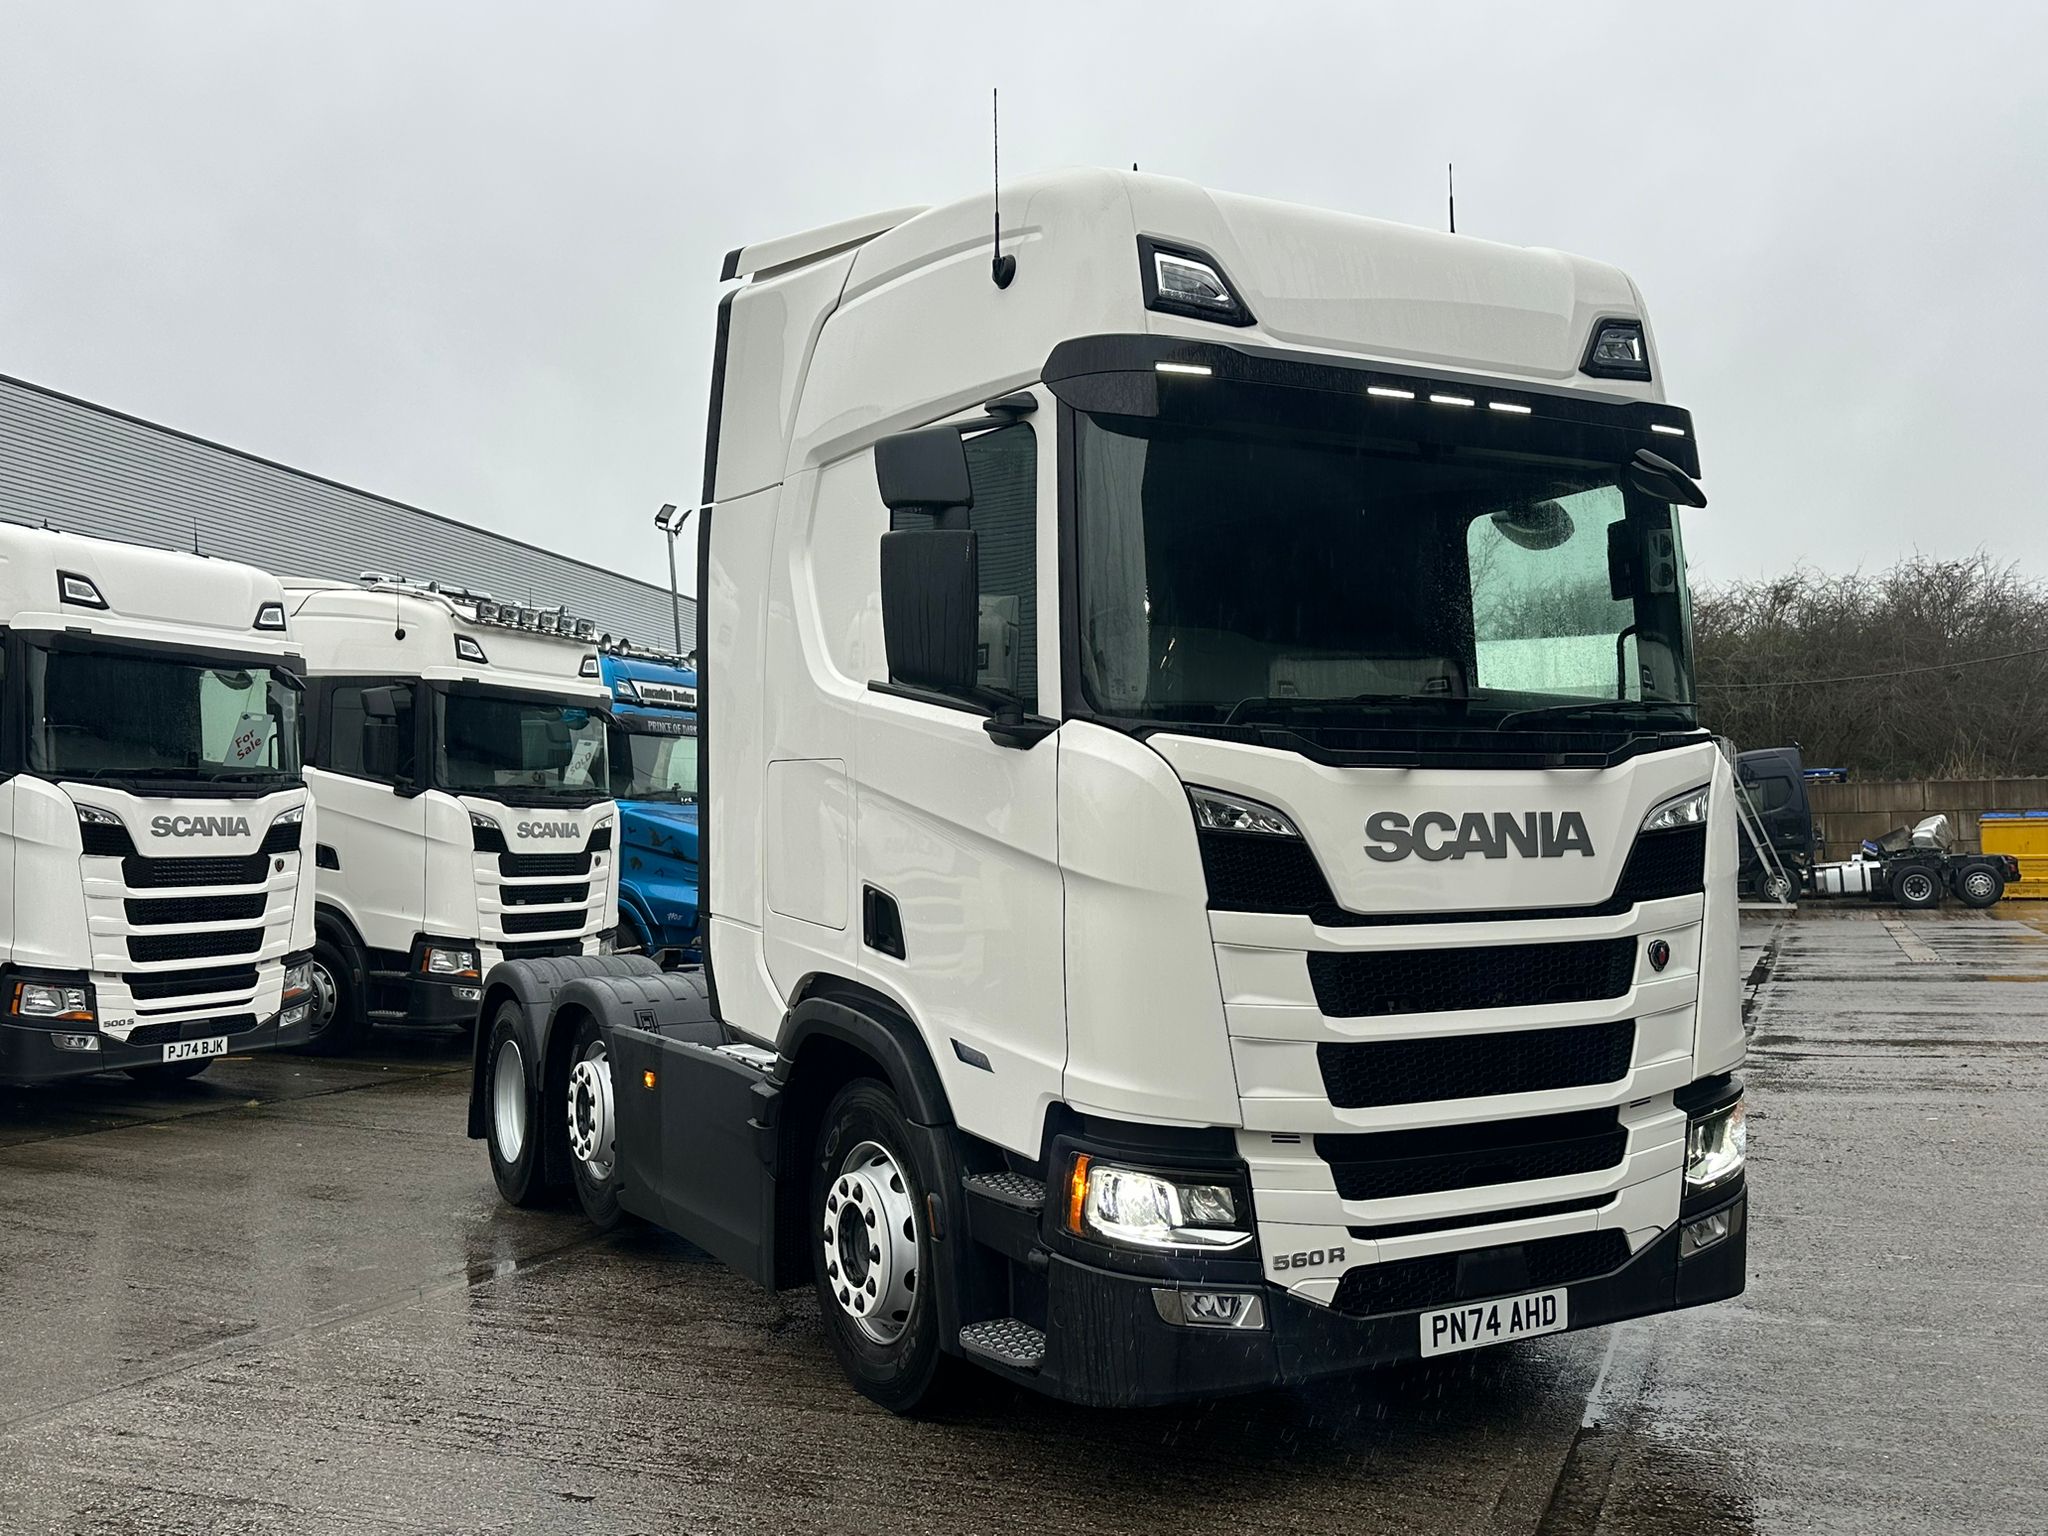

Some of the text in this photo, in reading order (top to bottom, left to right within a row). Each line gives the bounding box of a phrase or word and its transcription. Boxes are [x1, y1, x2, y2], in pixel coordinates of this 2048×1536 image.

[235, 729, 254, 748] For
[237, 737, 262, 760] Sale
[150, 816, 251, 837] SCANIA
[517, 822, 580, 838] SCANIA
[1364, 811, 1595, 862] SCANIA
[104, 1018, 134, 1028] 500 S
[168, 1039, 223, 1059] PJ74 BJK
[1272, 1246, 1346, 1271] 560 R
[1432, 1294, 1557, 1348] PN74 AHD
